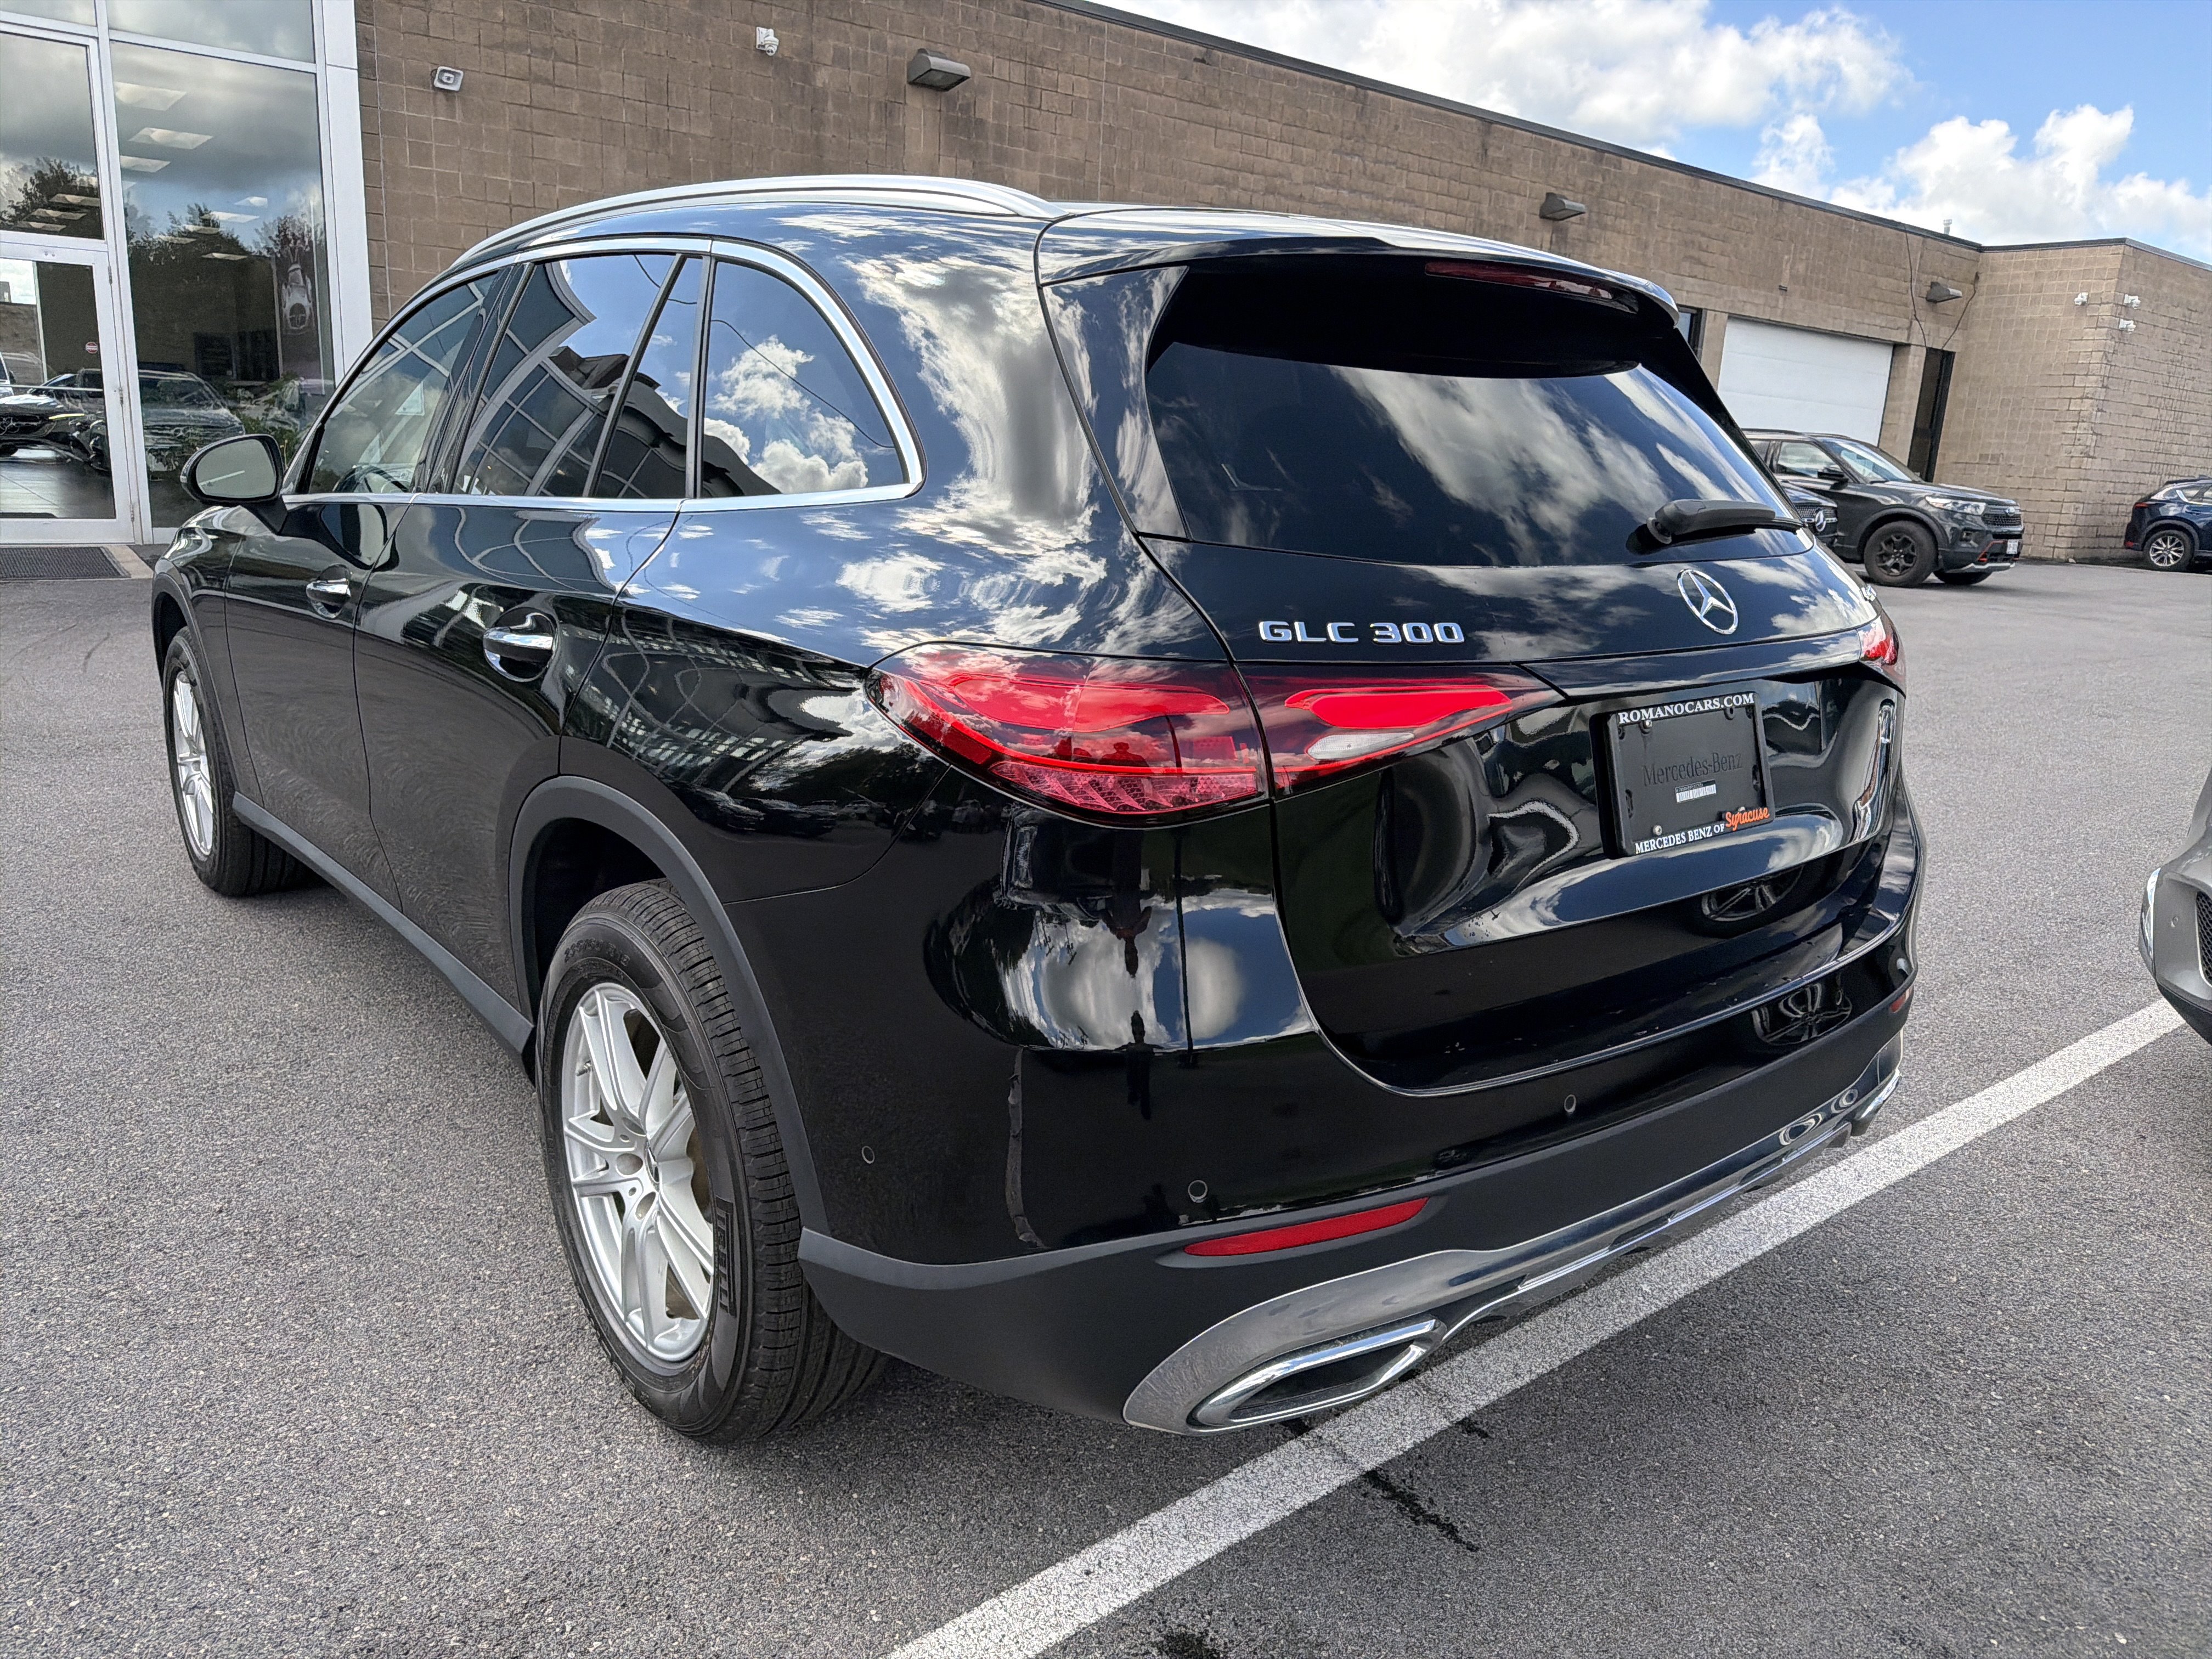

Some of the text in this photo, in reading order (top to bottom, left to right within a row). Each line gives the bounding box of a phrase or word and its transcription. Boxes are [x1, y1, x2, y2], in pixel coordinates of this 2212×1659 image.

[1259, 620, 1465, 644] GLC 300
[1618, 693, 1754, 724] ROMANOCARS.COM
[1643, 752, 1743, 786] Mercedes-Benz
[1635, 806, 1770, 854] MERCEDES BENZ OF Syracuse
[715, 1195, 737, 1318] PIRELLI
